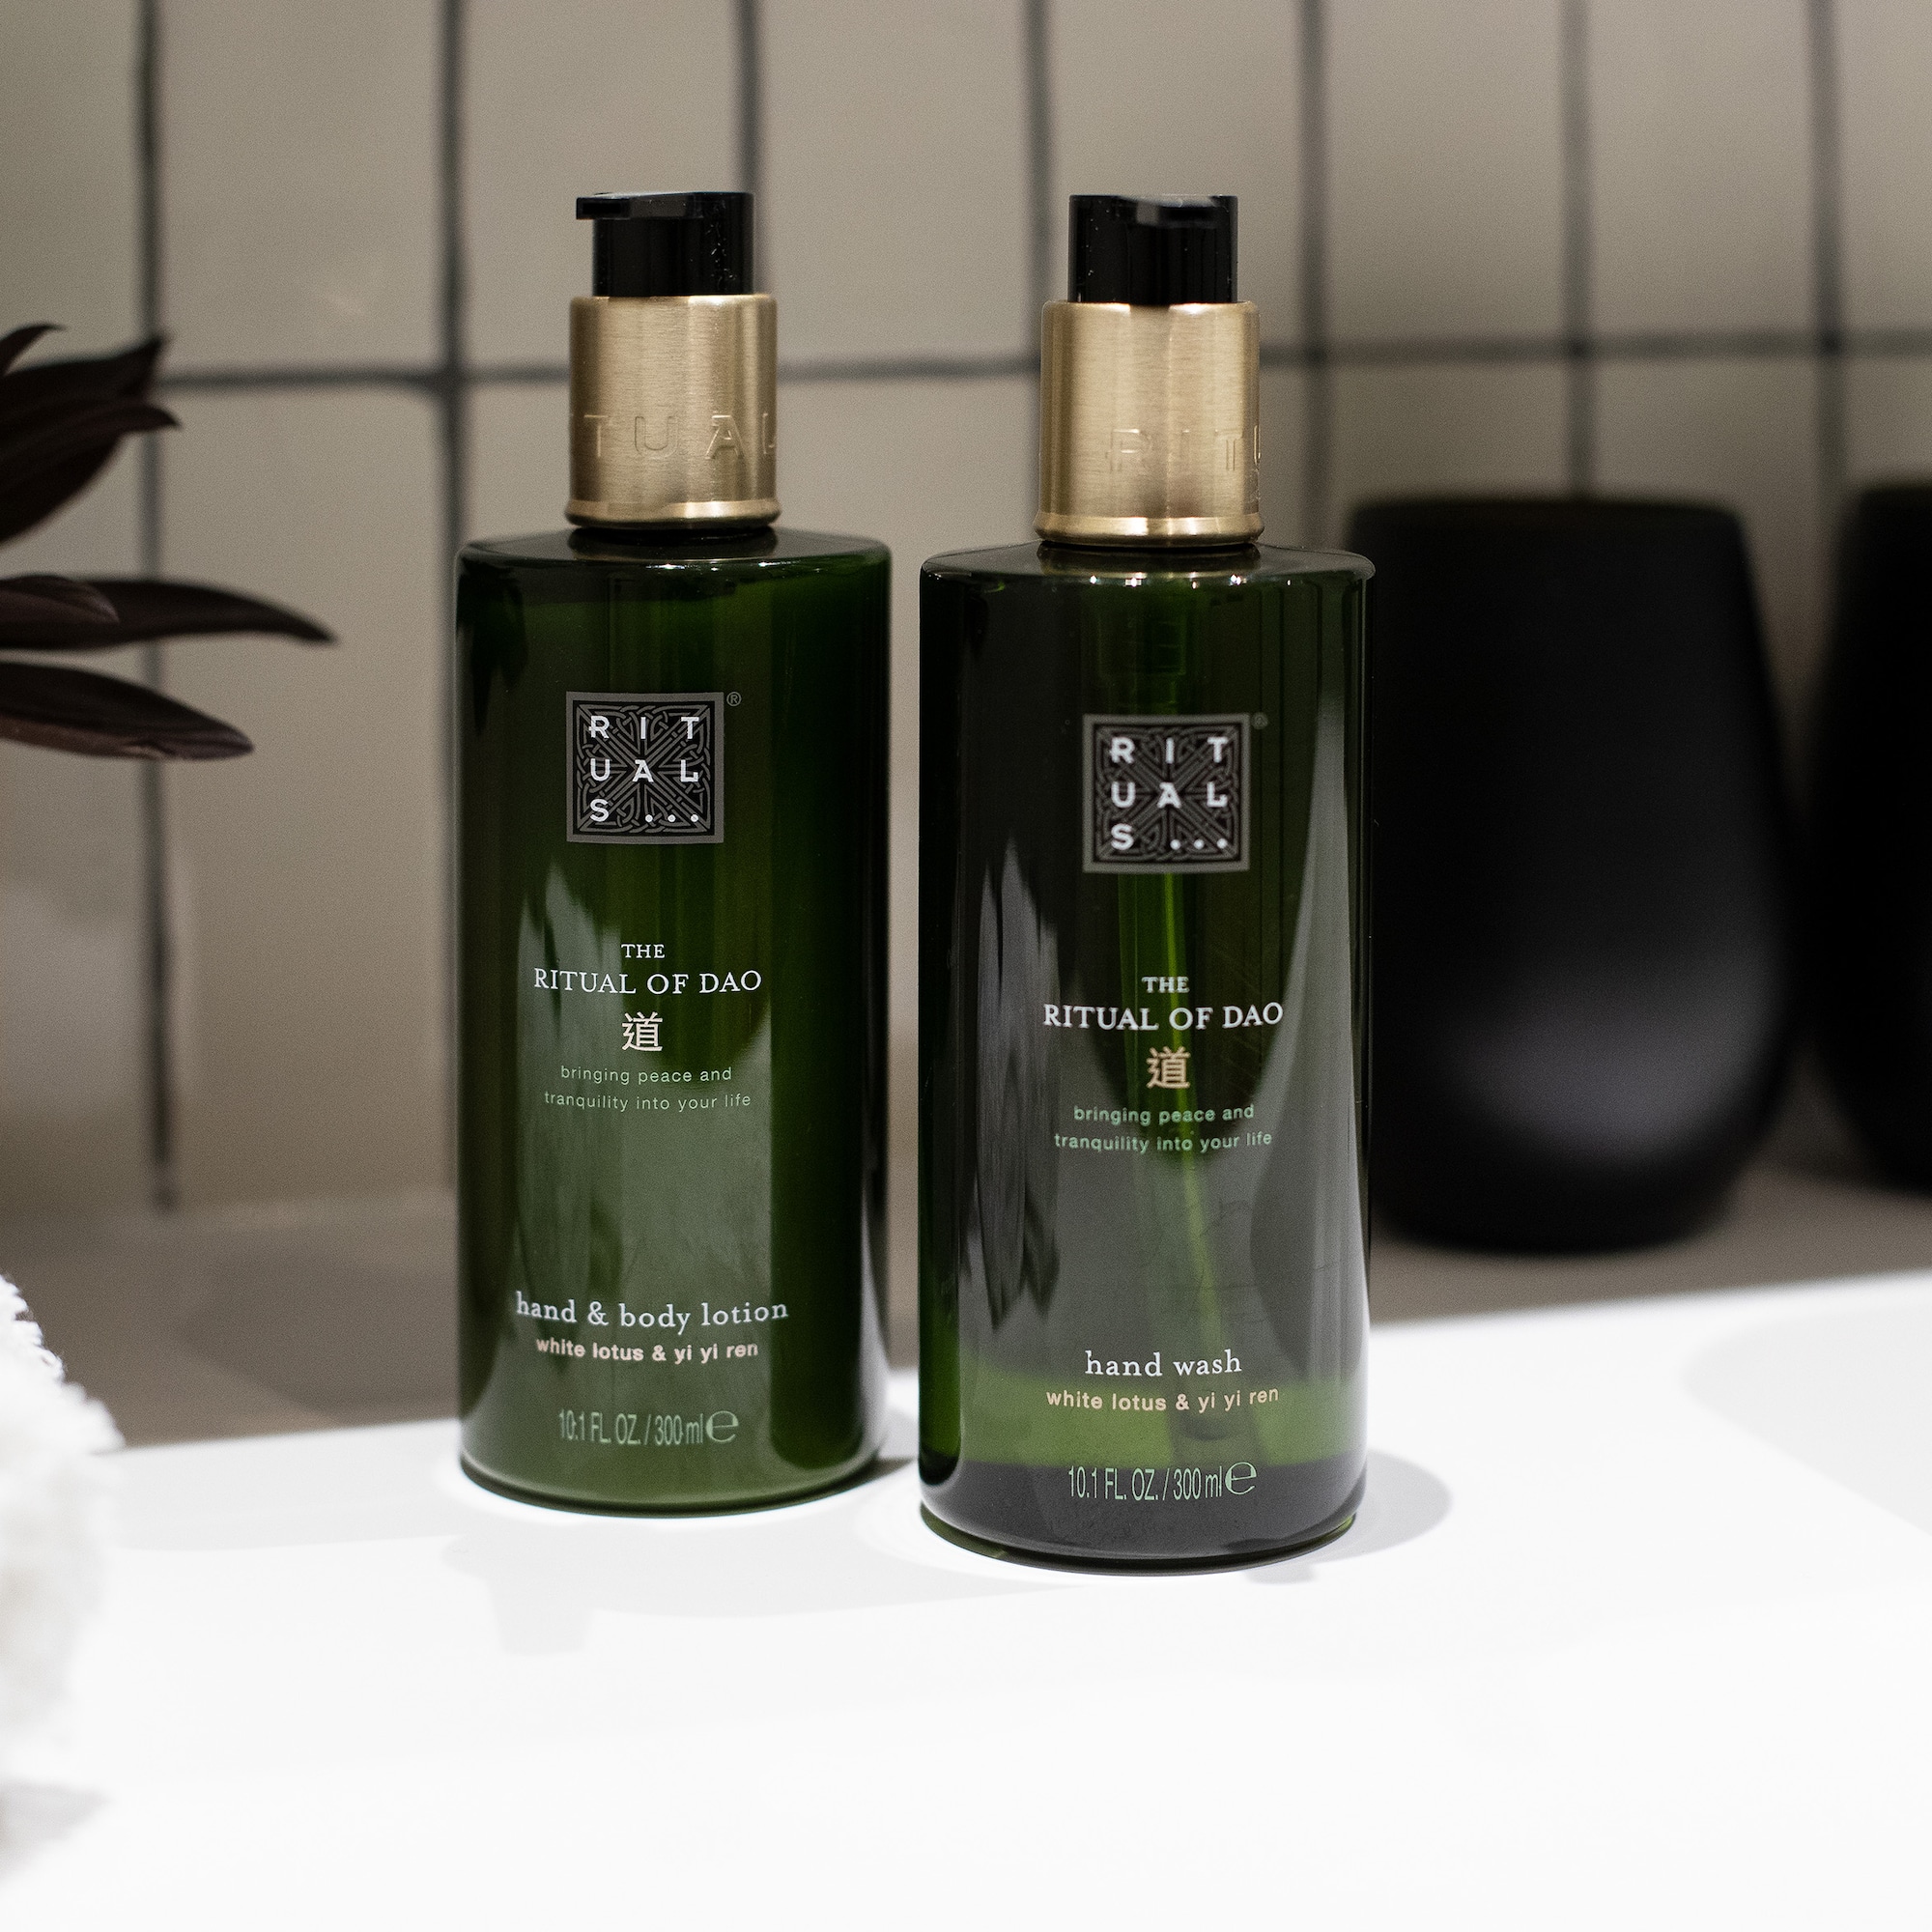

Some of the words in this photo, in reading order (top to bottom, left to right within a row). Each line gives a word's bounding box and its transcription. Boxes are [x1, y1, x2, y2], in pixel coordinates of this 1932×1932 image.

[588, 715, 699, 740] RIT
[1110, 736, 1229, 764] RIT
[590, 758, 698, 782] UAL
[1112, 781, 1229, 809] UAL
[621, 944, 666, 958] THE
[533, 968, 637, 994] RITUAL
[647, 974, 689, 995] OF
[699, 970, 762, 994] DAO
[1141, 976, 1190, 993] THE
[1043, 1003, 1159, 1031] RITUAL
[1169, 1007, 1213, 1031] OF
[1222, 1002, 1284, 1029] DAO
[621, 1011, 663, 1052] 道
[560, 1065, 630, 1085] bringing
[639, 1069, 692, 1085] peace
[699, 1066, 732, 1081] and
[1146, 1045, 1191, 1090] 道
[545, 1092, 629, 1112] tranquility
[637, 1096, 670, 1110] into
[678, 1095, 718, 1112] your
[724, 1093, 752, 1107] life
[1074, 1105, 1151, 1126] bringing
[1159, 1109, 1215, 1125] peace
[1222, 1103, 1255, 1121] and
[1054, 1133, 1150, 1153] tranquility
[1156, 1136, 1193, 1151] into
[1200, 1136, 1240, 1153] your
[1246, 1130, 1272, 1147] life
[515, 1291, 578, 1323] hand
[587, 1300, 609, 1326] &
[619, 1303, 691, 1335] body
[700, 1301, 788, 1326] lotion
[536, 1337, 585, 1358] white
[592, 1342, 644, 1362] lotus
[652, 1344, 667, 1362] &
[674, 1345, 692, 1365] yi
[700, 1343, 718, 1364] yi
[726, 1342, 758, 1358] ren
[1085, 1350, 1163, 1377] hand
[1173, 1349, 1242, 1376] wash
[1046, 1390, 1103, 1409] white
[1112, 1393, 1167, 1411] lotus
[1175, 1393, 1189, 1411] &
[1198, 1392, 1215, 1413] yi
[1224, 1390, 1240, 1411] yi
[1249, 1388, 1279, 1405] ren
[558, 1408, 585, 1440] 10.1
[615, 1413, 640, 1445] OZ.
[654, 1414, 683, 1446] 300
[1068, 1465, 1097, 1498] 10.1
[1105, 1467, 1126, 1500] FL.
[1132, 1468, 1158, 1501] OZ.
[1163, 1467, 1169, 1501] /
[1174, 1467, 1201, 1500] 300
